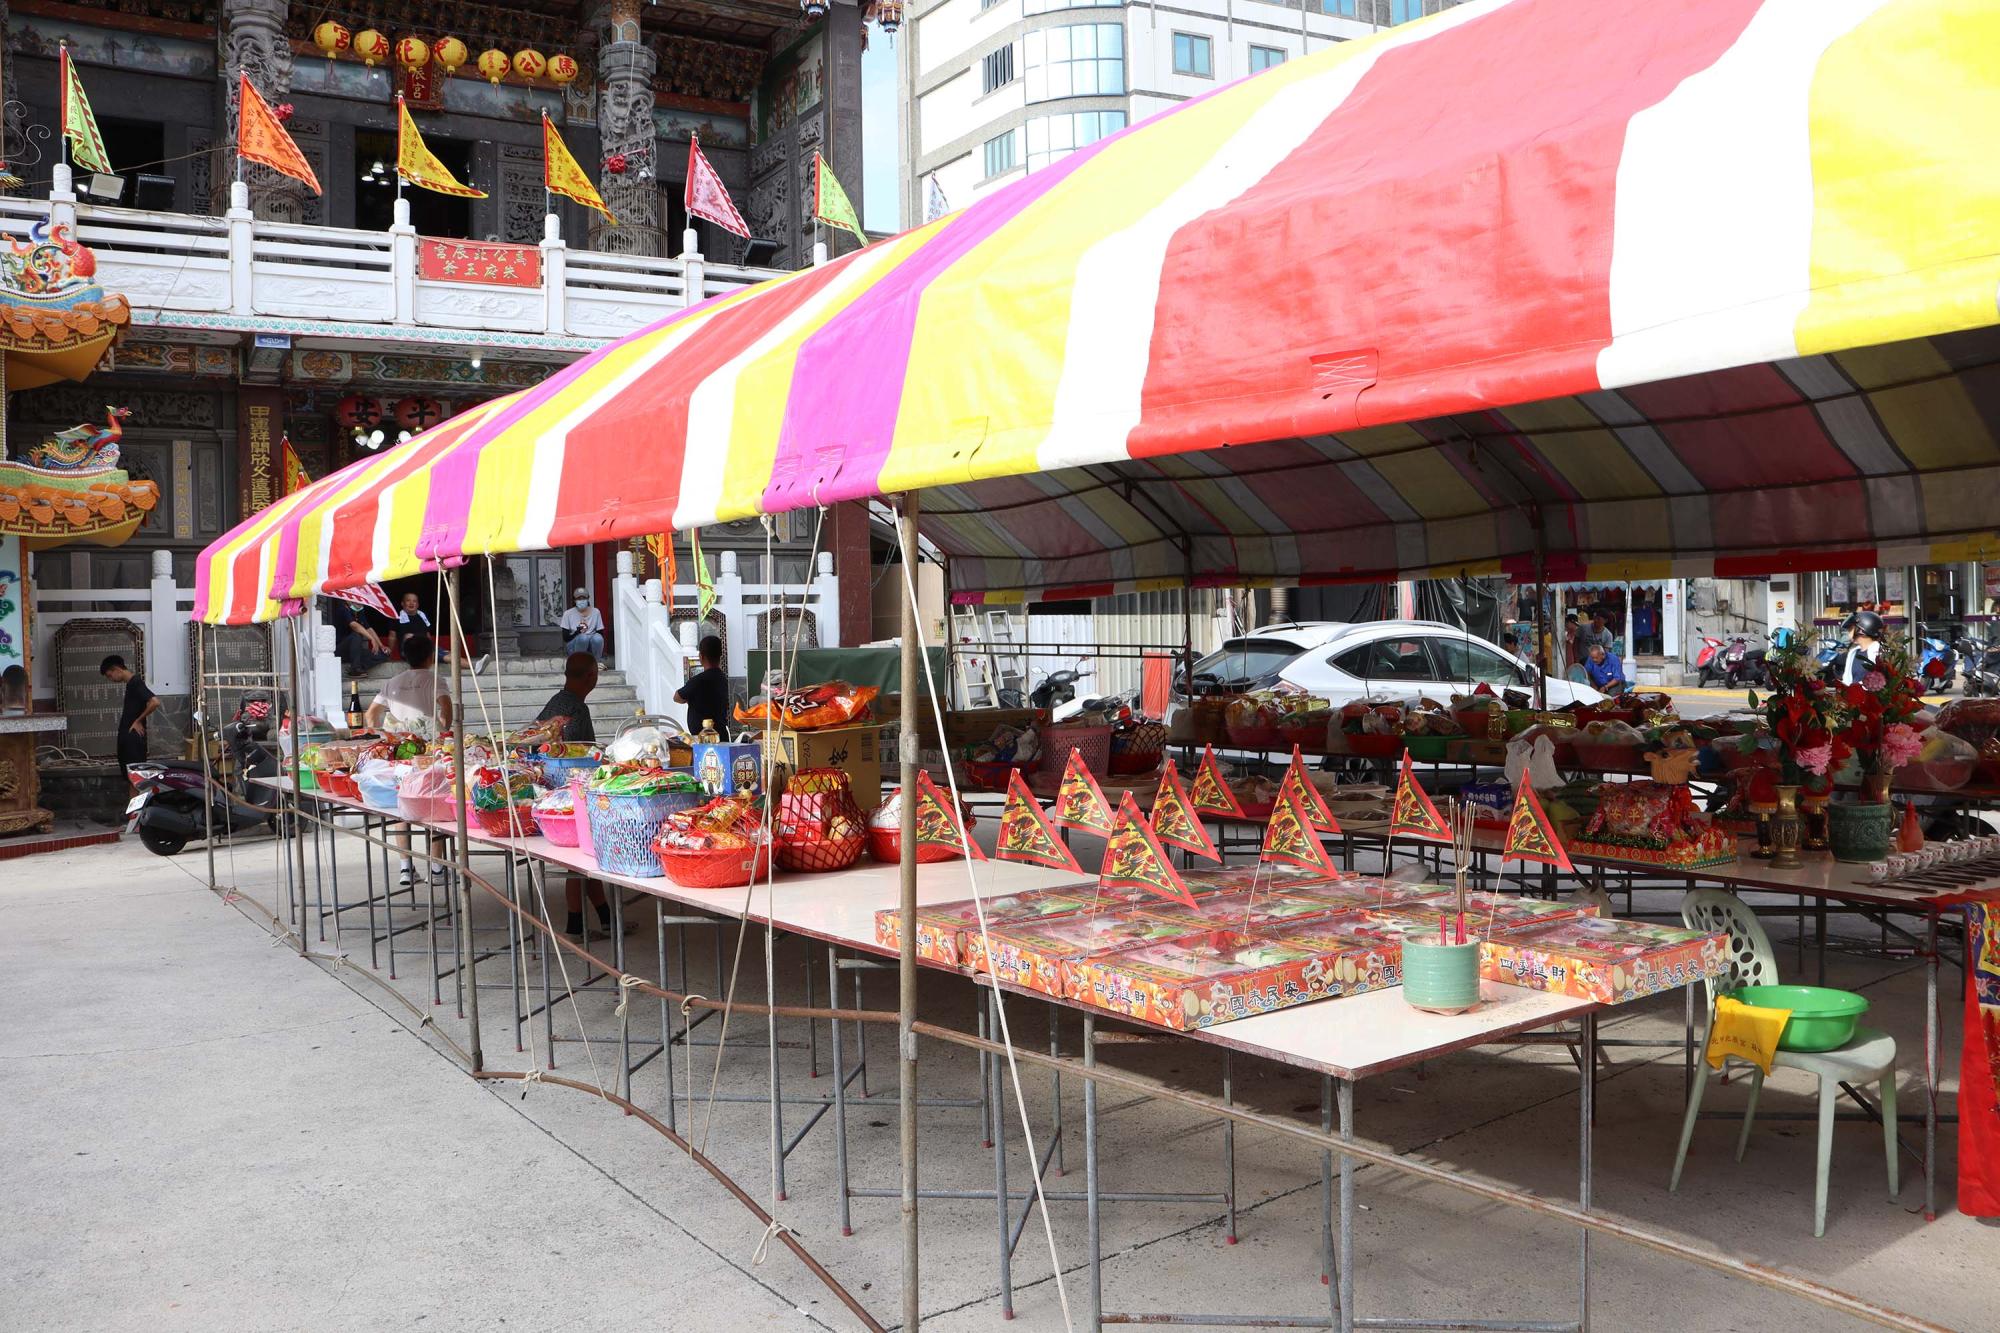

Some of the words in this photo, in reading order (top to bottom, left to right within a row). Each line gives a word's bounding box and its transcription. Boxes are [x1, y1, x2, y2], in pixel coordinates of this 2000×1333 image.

[1647, 959, 1699, 987] 國泰民安
[1229, 980, 1300, 1012] 國泰民安
